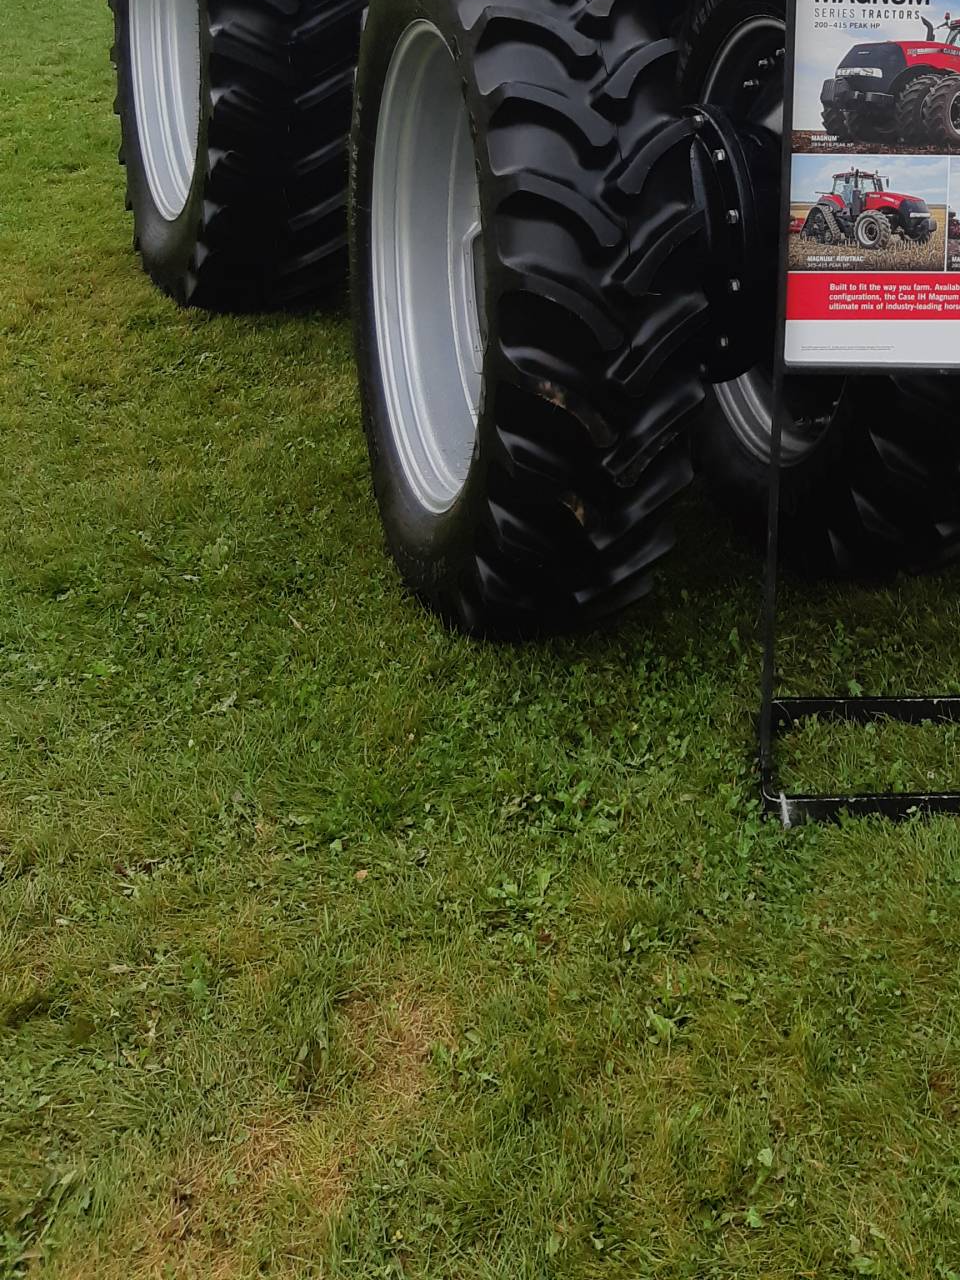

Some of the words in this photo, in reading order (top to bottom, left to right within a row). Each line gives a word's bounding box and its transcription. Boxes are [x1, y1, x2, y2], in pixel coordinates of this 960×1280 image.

[814, 8, 855, 19] SERIES
[862, 9, 921, 20] TRACTORS
[830, 283, 847, 291] Built
[849, 283, 857, 291] to
[859, 283, 867, 291] fit
[869, 283, 881, 291] the
[883, 283, 896, 292] way
[898, 283, 911, 292] you
[913, 283, 932, 291] farm.
[829, 293, 882, 302] configurations,
[884, 293, 896, 301] the
[898, 293, 915, 301] Case
[917, 293, 926, 301] IH
[928, 293, 959, 302] Magnum
[829, 302, 858, 310] ultimate
[860, 302, 873, 310] mix
[876, 302, 883, 310] of
[885, 302, 942, 311] industry-leading
